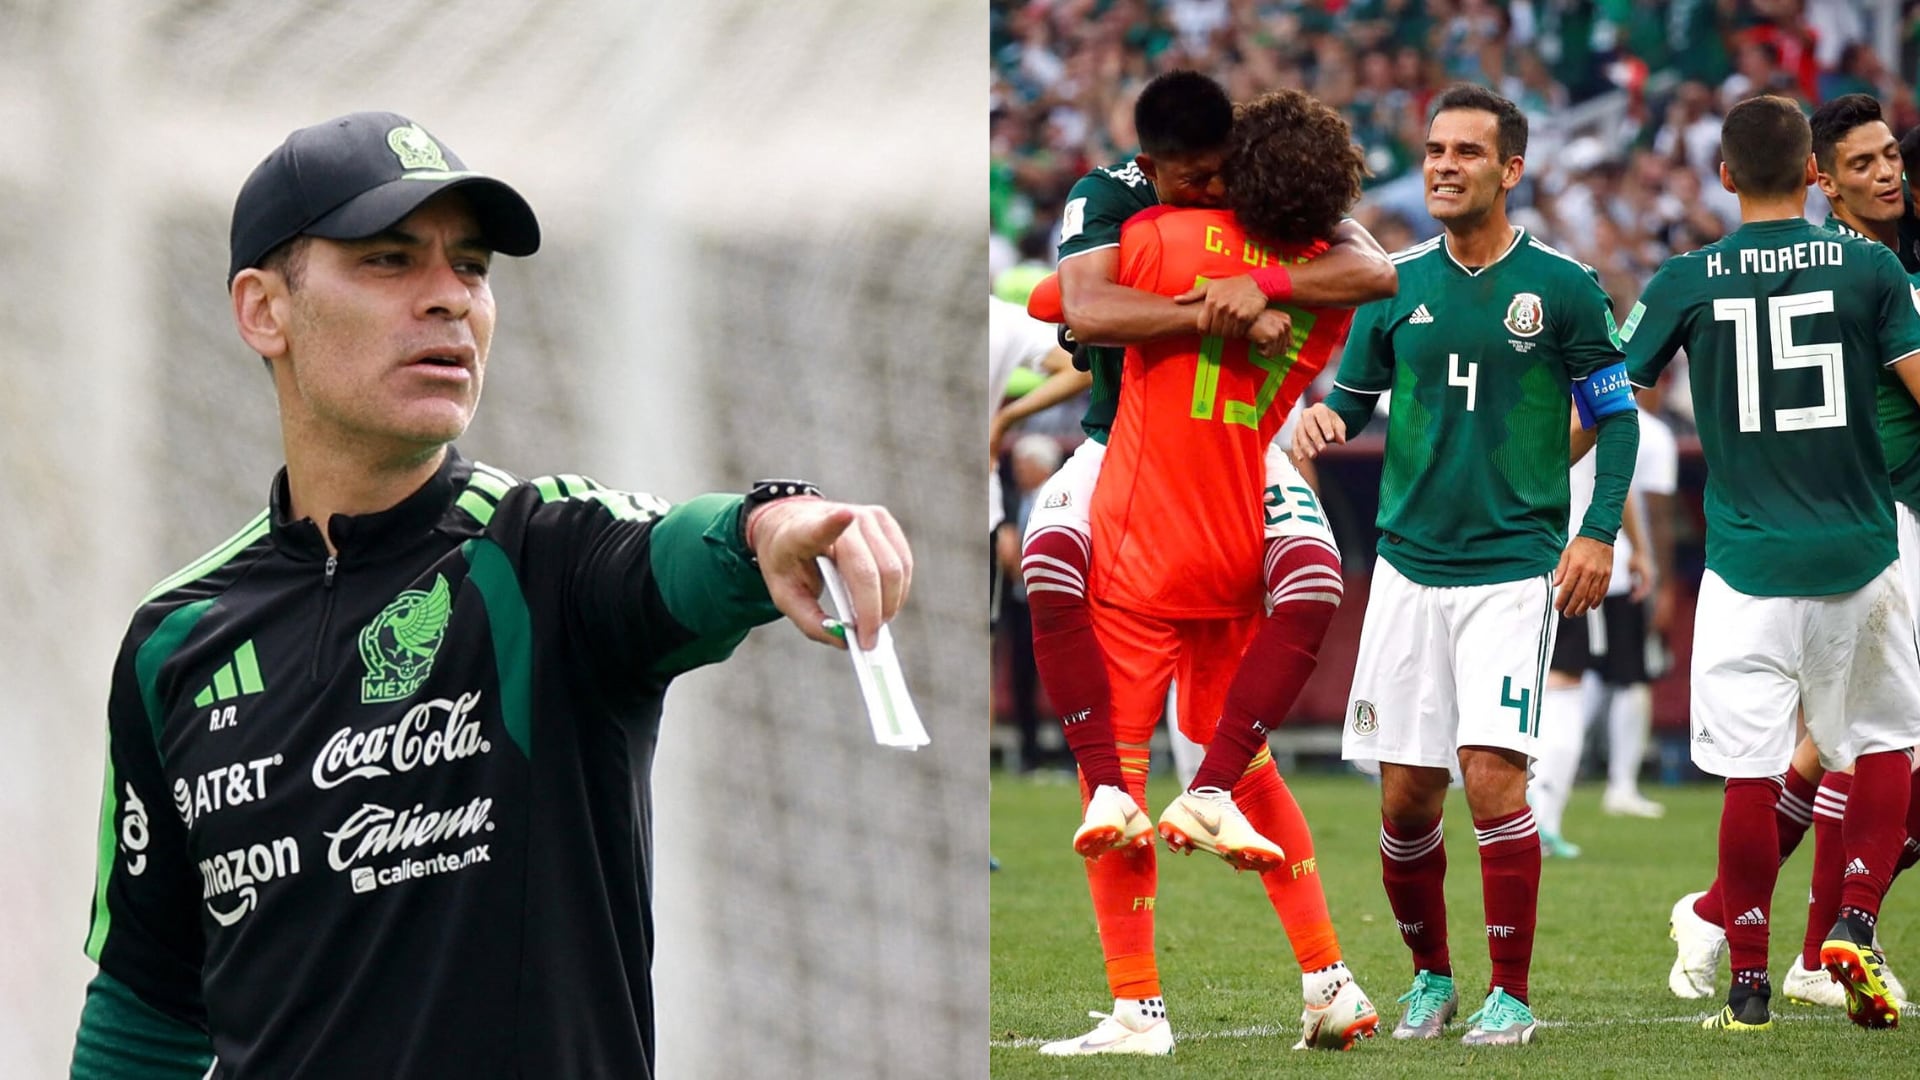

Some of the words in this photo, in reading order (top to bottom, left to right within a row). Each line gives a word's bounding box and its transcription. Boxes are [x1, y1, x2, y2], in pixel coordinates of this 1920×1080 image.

[1205, 225, 1231, 256] G.
[1707, 252, 1730, 278] H.
[1740, 241, 1843, 274] MORENO
[1448, 353, 1478, 412] 4
[1713, 290, 1848, 433] 15
[1263, 484, 1324, 526] 23
[366, 677, 424, 698] MÉXIC
[1500, 675, 1530, 733] 4
[209, 705, 238, 731] R.M.
[195, 756, 274, 818] AT&T
[323, 796, 492, 871] Caliente
[199, 836, 300, 899] mazon
[378, 844, 491, 886] caliente.mx
[1486, 925, 1516, 938] FMF
